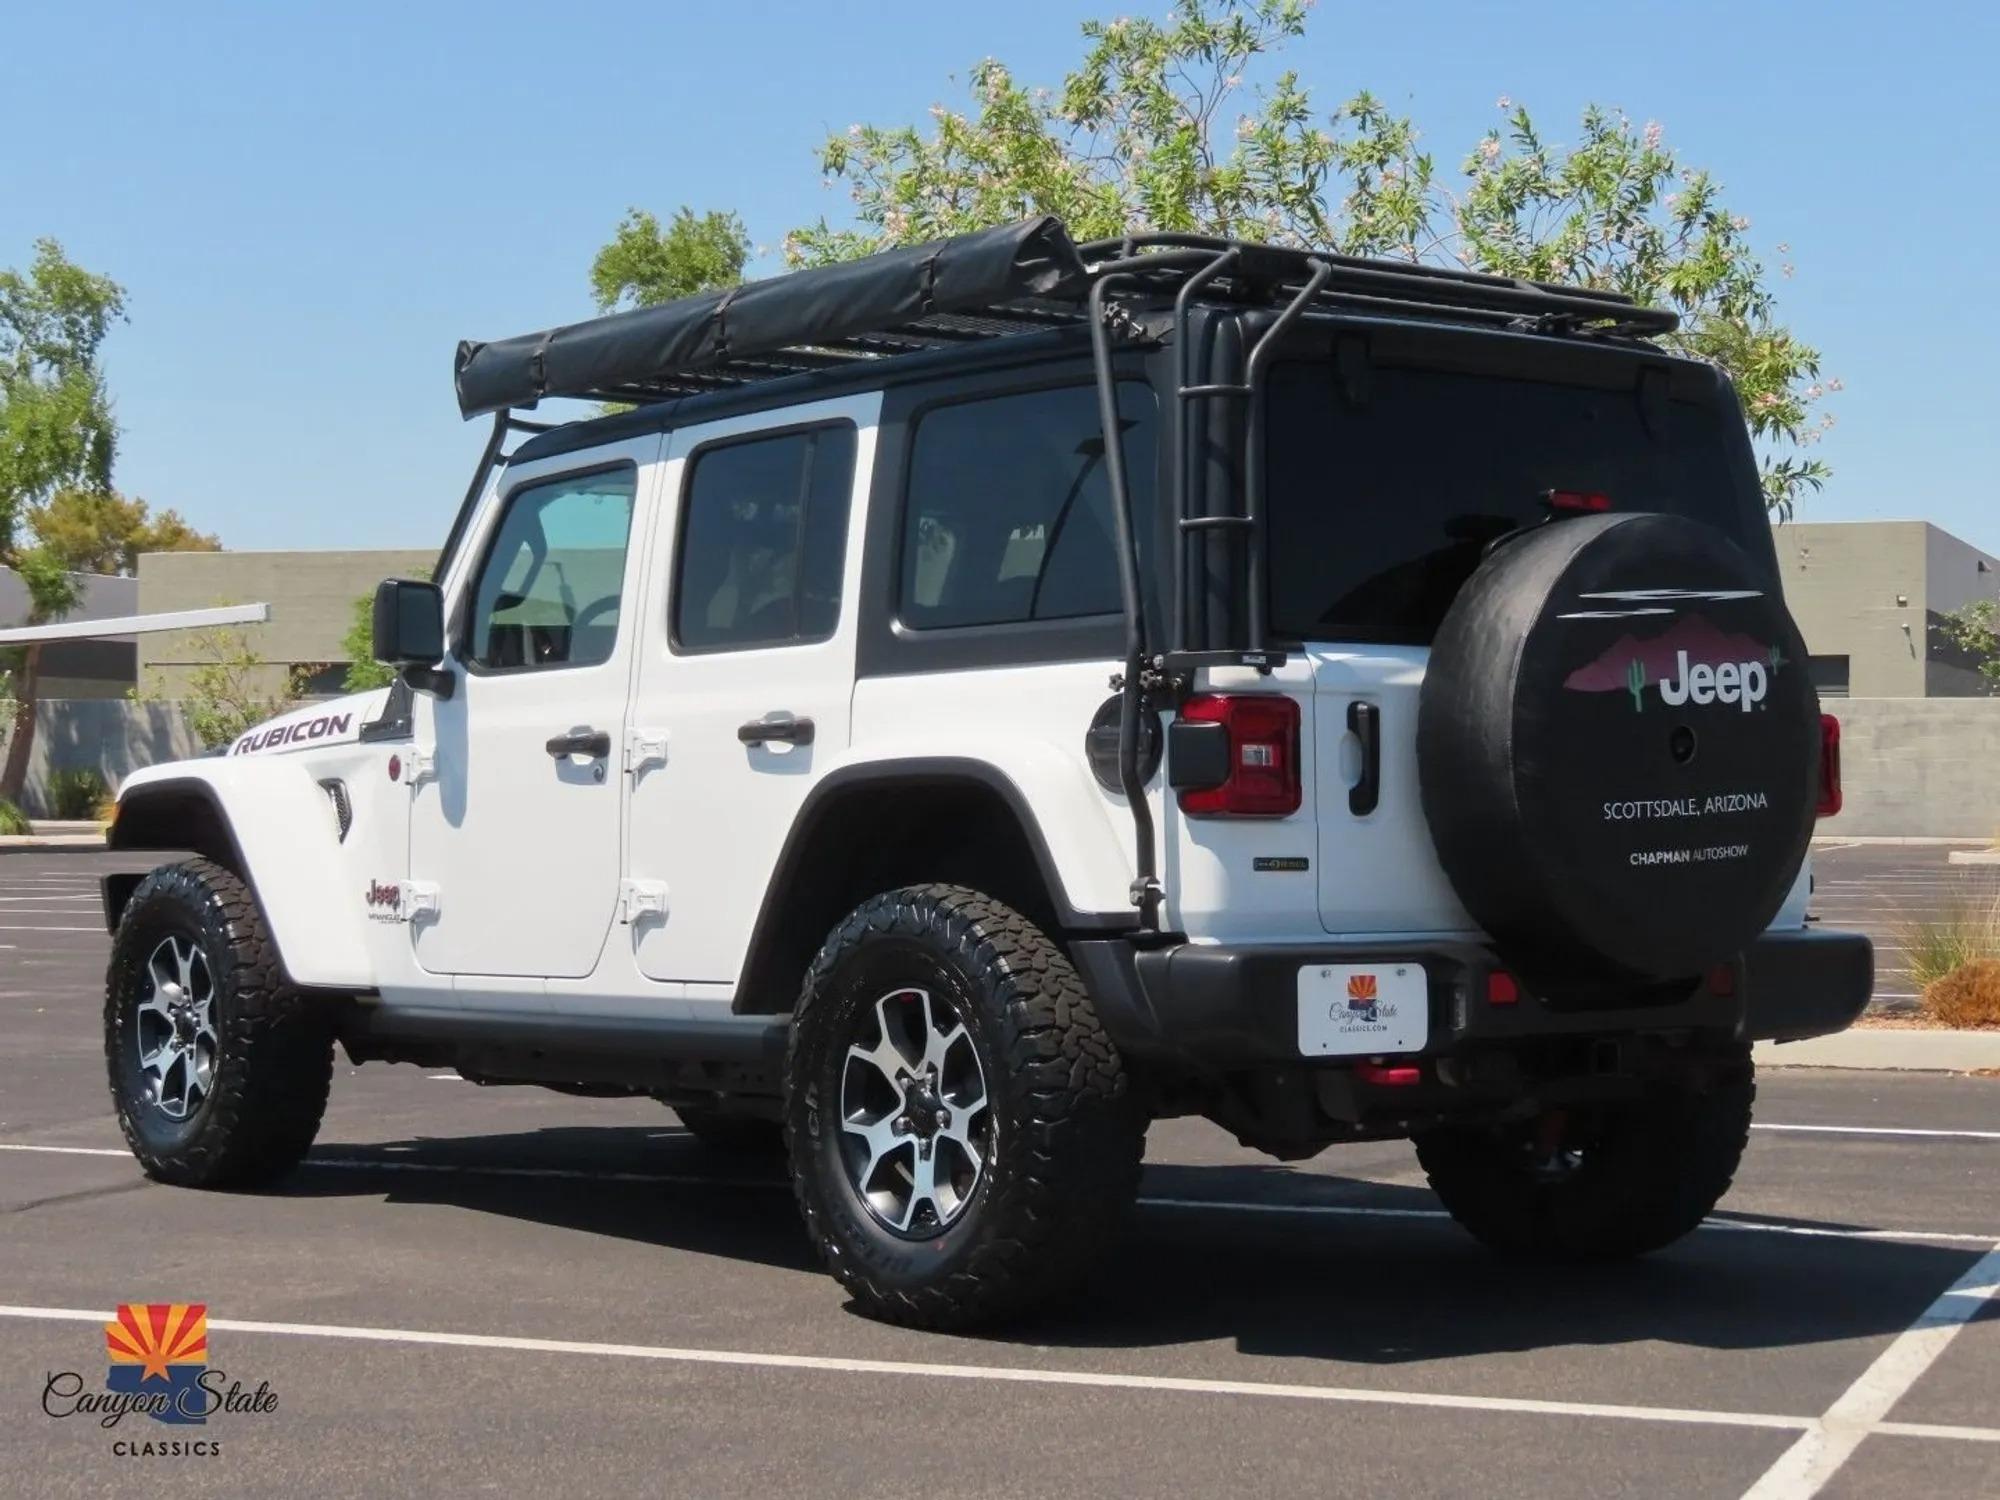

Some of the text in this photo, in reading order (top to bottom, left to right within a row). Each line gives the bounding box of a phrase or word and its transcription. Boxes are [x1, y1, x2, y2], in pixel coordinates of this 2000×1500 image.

[1659, 650, 1767, 712] Jeep
[234, 712, 353, 756] RUBICON
[1603, 792, 1768, 820] SCOTTSDALE, ARIZONA
[1629, 845, 1749, 866] CHAPMAN AUTOSHOW
[366, 879, 400, 912] Jeep
[1339, 1025, 1388, 1033] CLASSICS.COM
